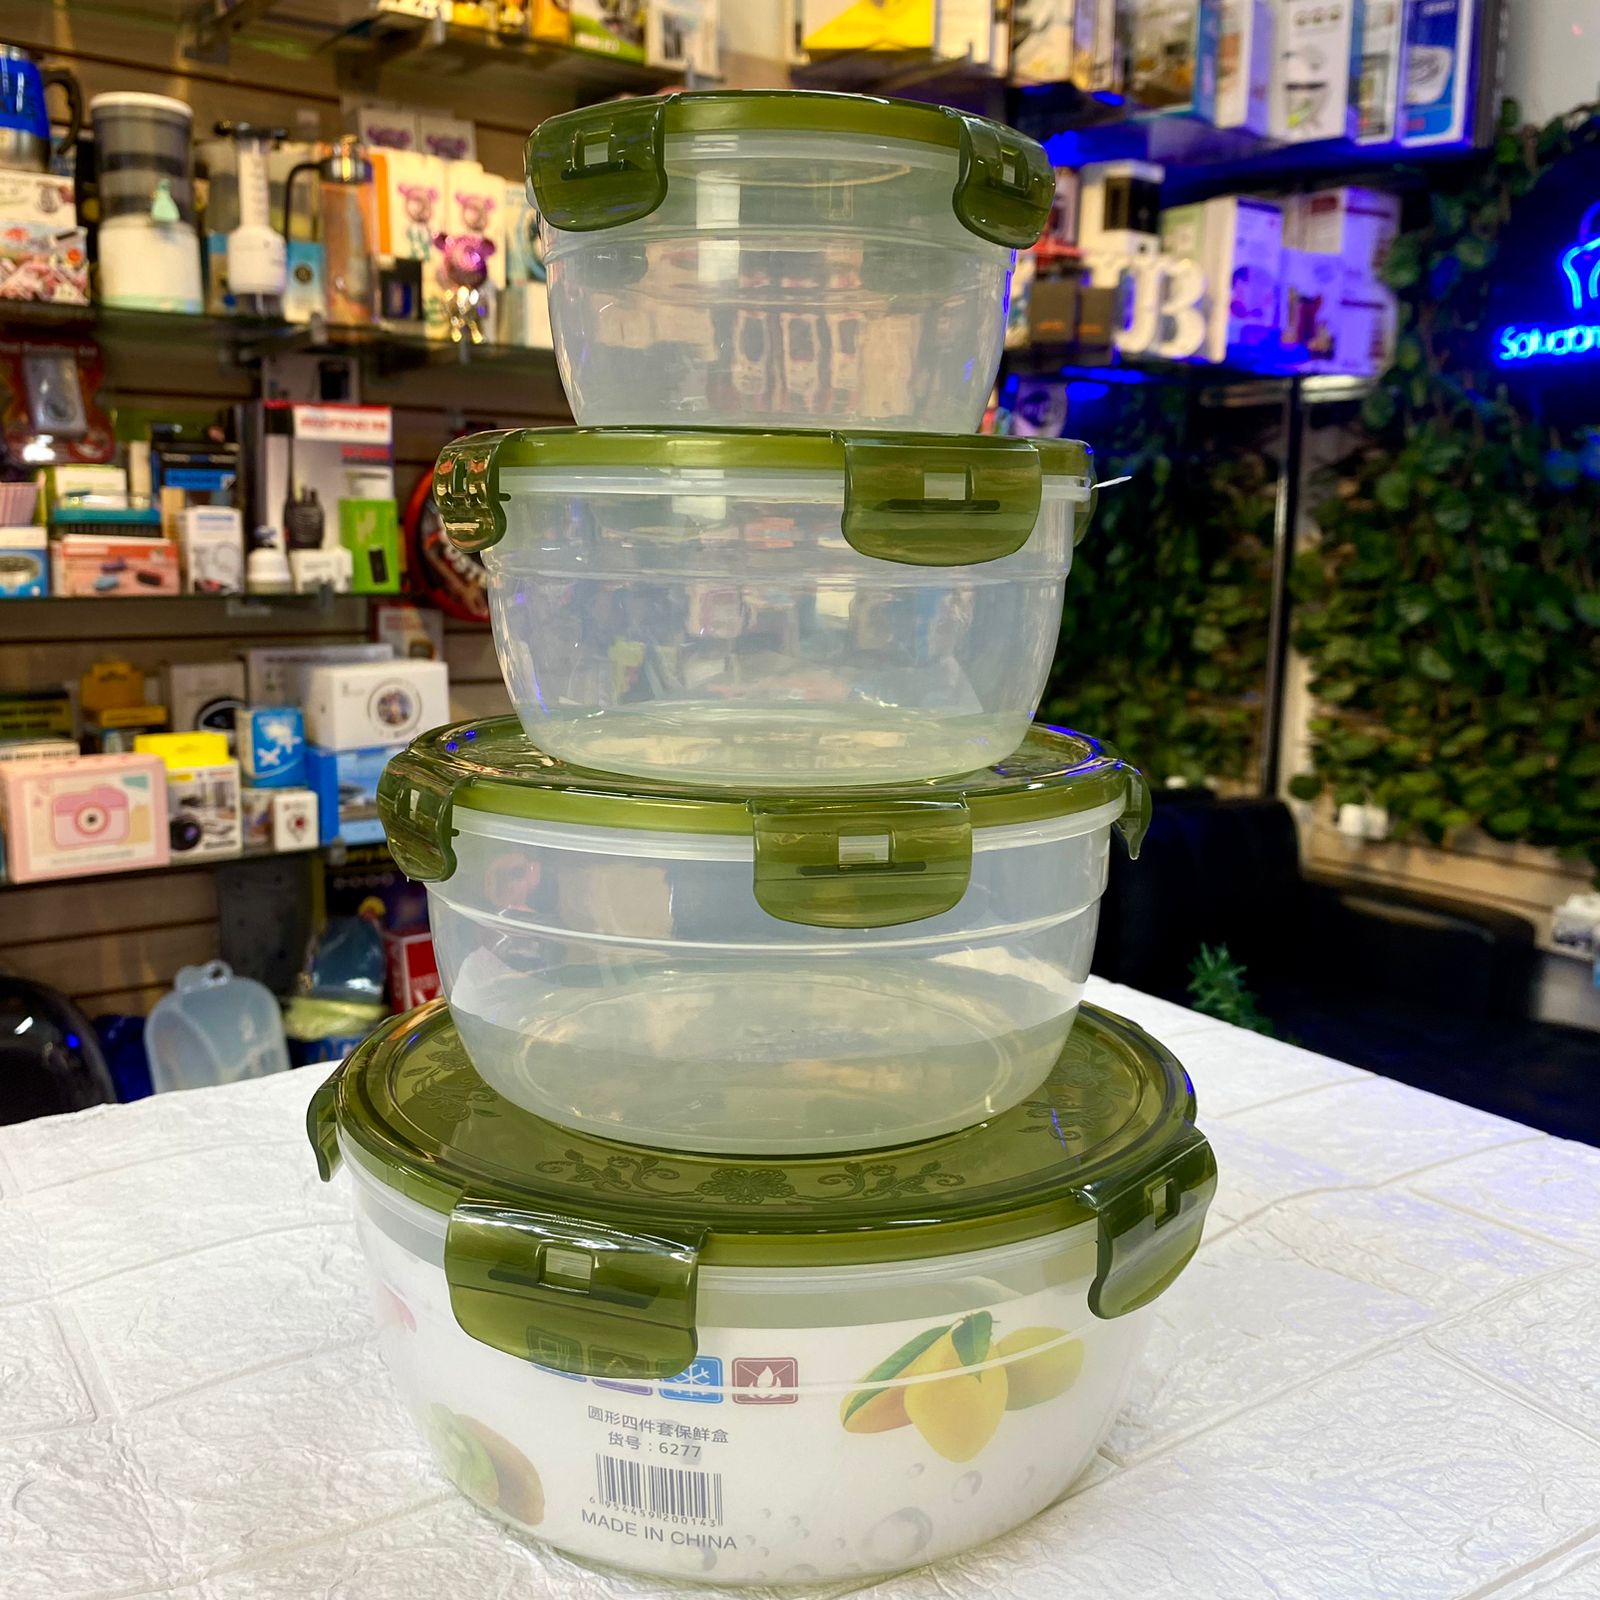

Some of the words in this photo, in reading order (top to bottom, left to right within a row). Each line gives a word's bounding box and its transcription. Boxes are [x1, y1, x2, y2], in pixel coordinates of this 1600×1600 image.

[587, 1405, 729, 1444] 圆形四件套保鲜盒
[581, 1508, 638, 1537] MADE
[644, 1525, 664, 1542] IN
[670, 1531, 738, 1550] CHINA
